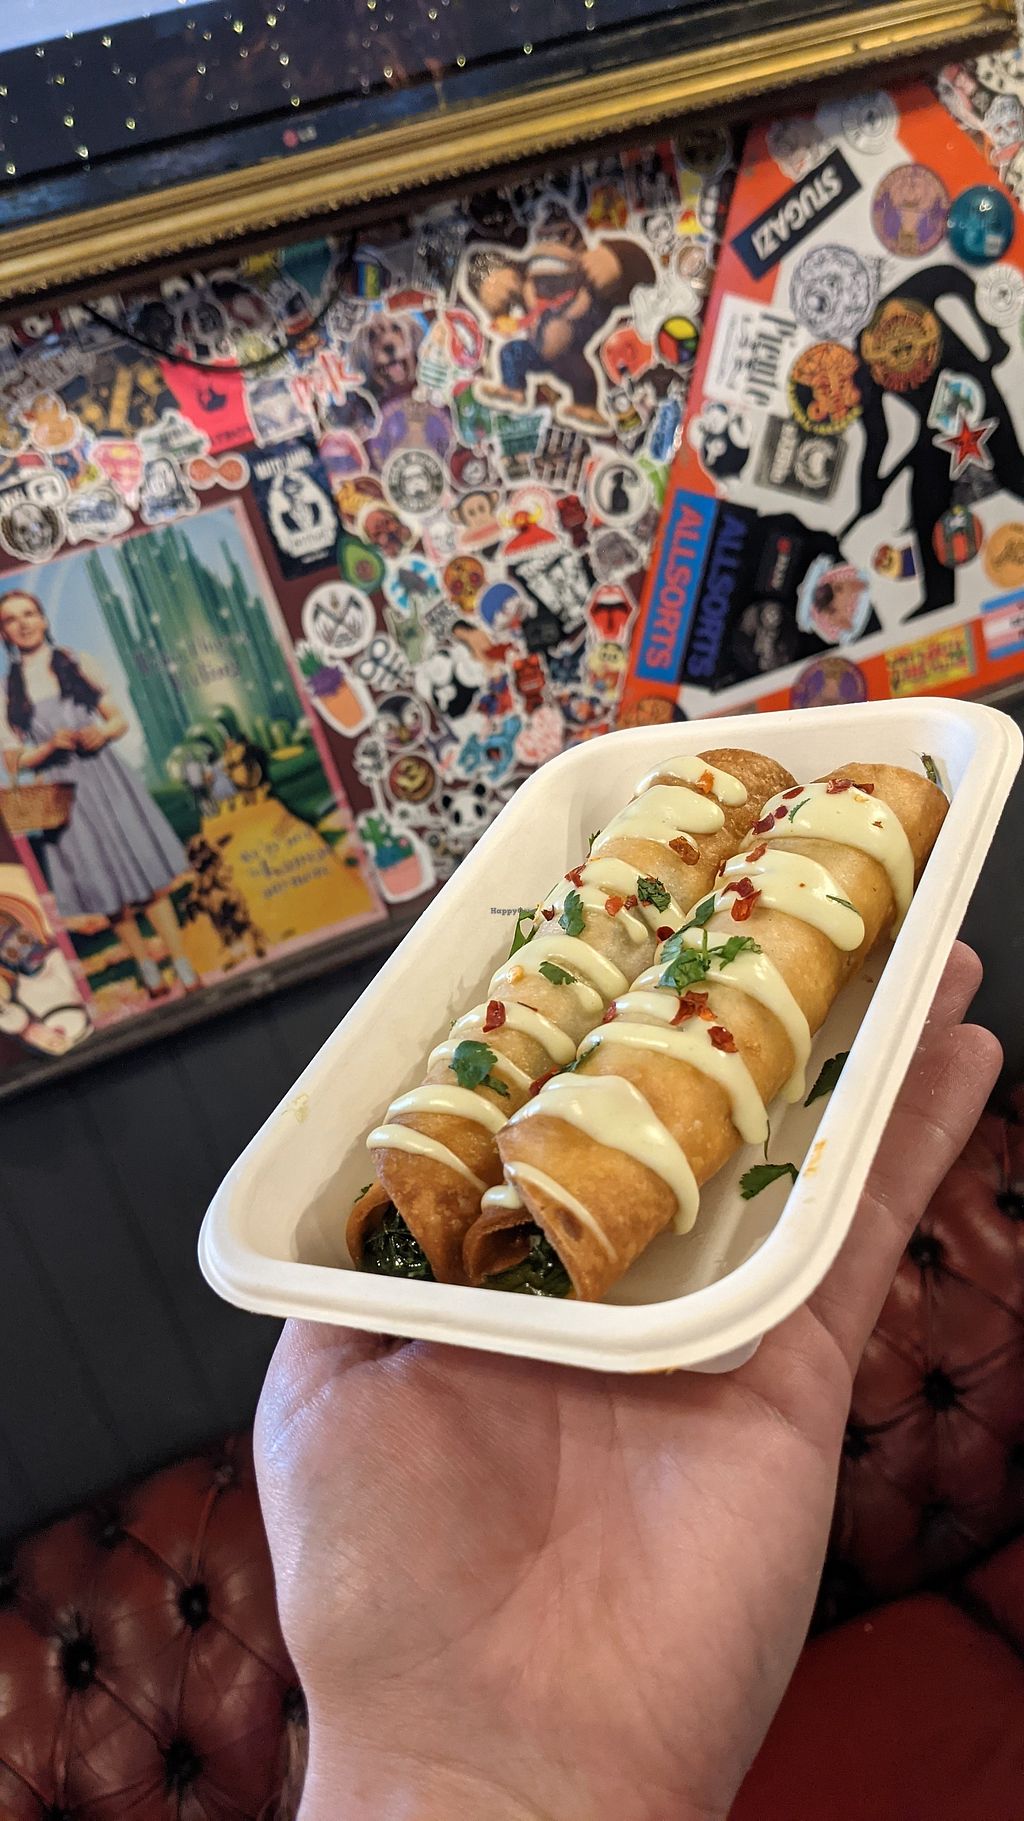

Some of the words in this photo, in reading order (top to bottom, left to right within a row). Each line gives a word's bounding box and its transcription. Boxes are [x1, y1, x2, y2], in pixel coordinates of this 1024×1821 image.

[751, 165, 842, 260] STUGAZI
[646, 504, 704, 669] ALLSORTS
[687, 513, 747, 677] ALLSORTS
